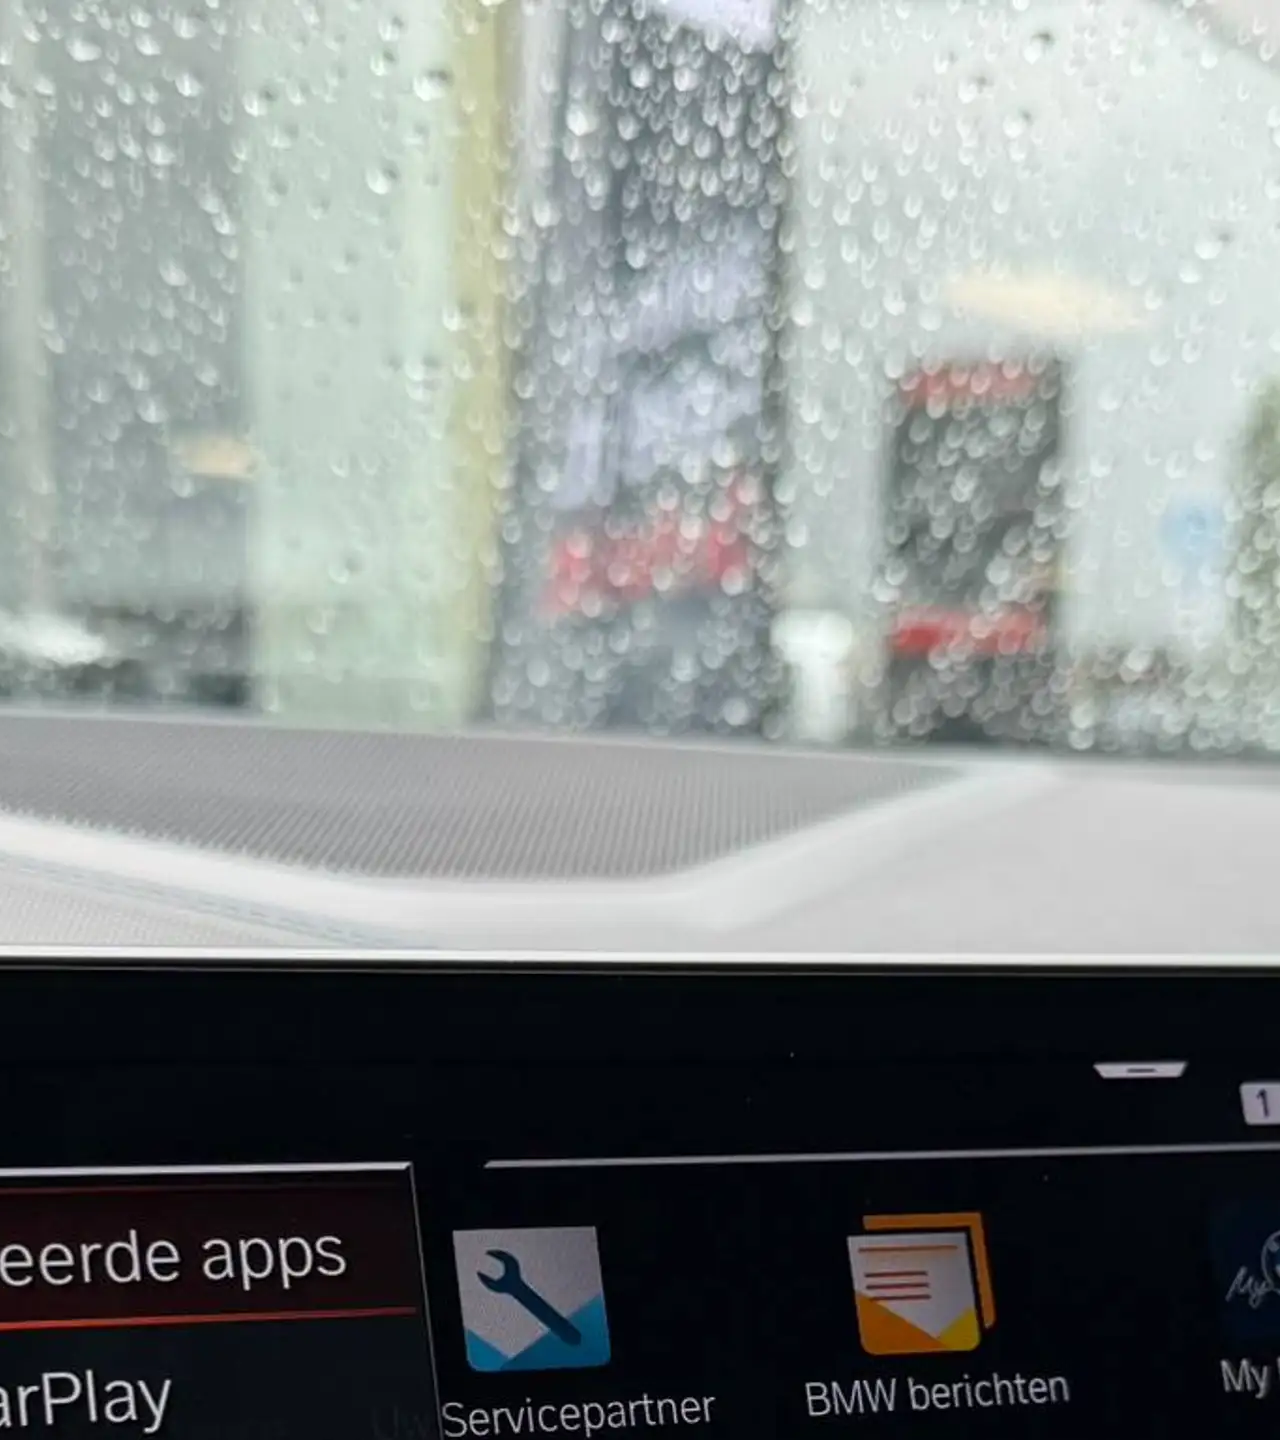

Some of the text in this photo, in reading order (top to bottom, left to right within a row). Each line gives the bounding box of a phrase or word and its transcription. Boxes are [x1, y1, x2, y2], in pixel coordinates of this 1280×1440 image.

[202, 1234, 348, 1291] apps
[805, 1372, 1070, 1417] BMW berichten
[1221, 1358, 1269, 1398] My
[442, 1393, 716, 1438] Servicepartner
